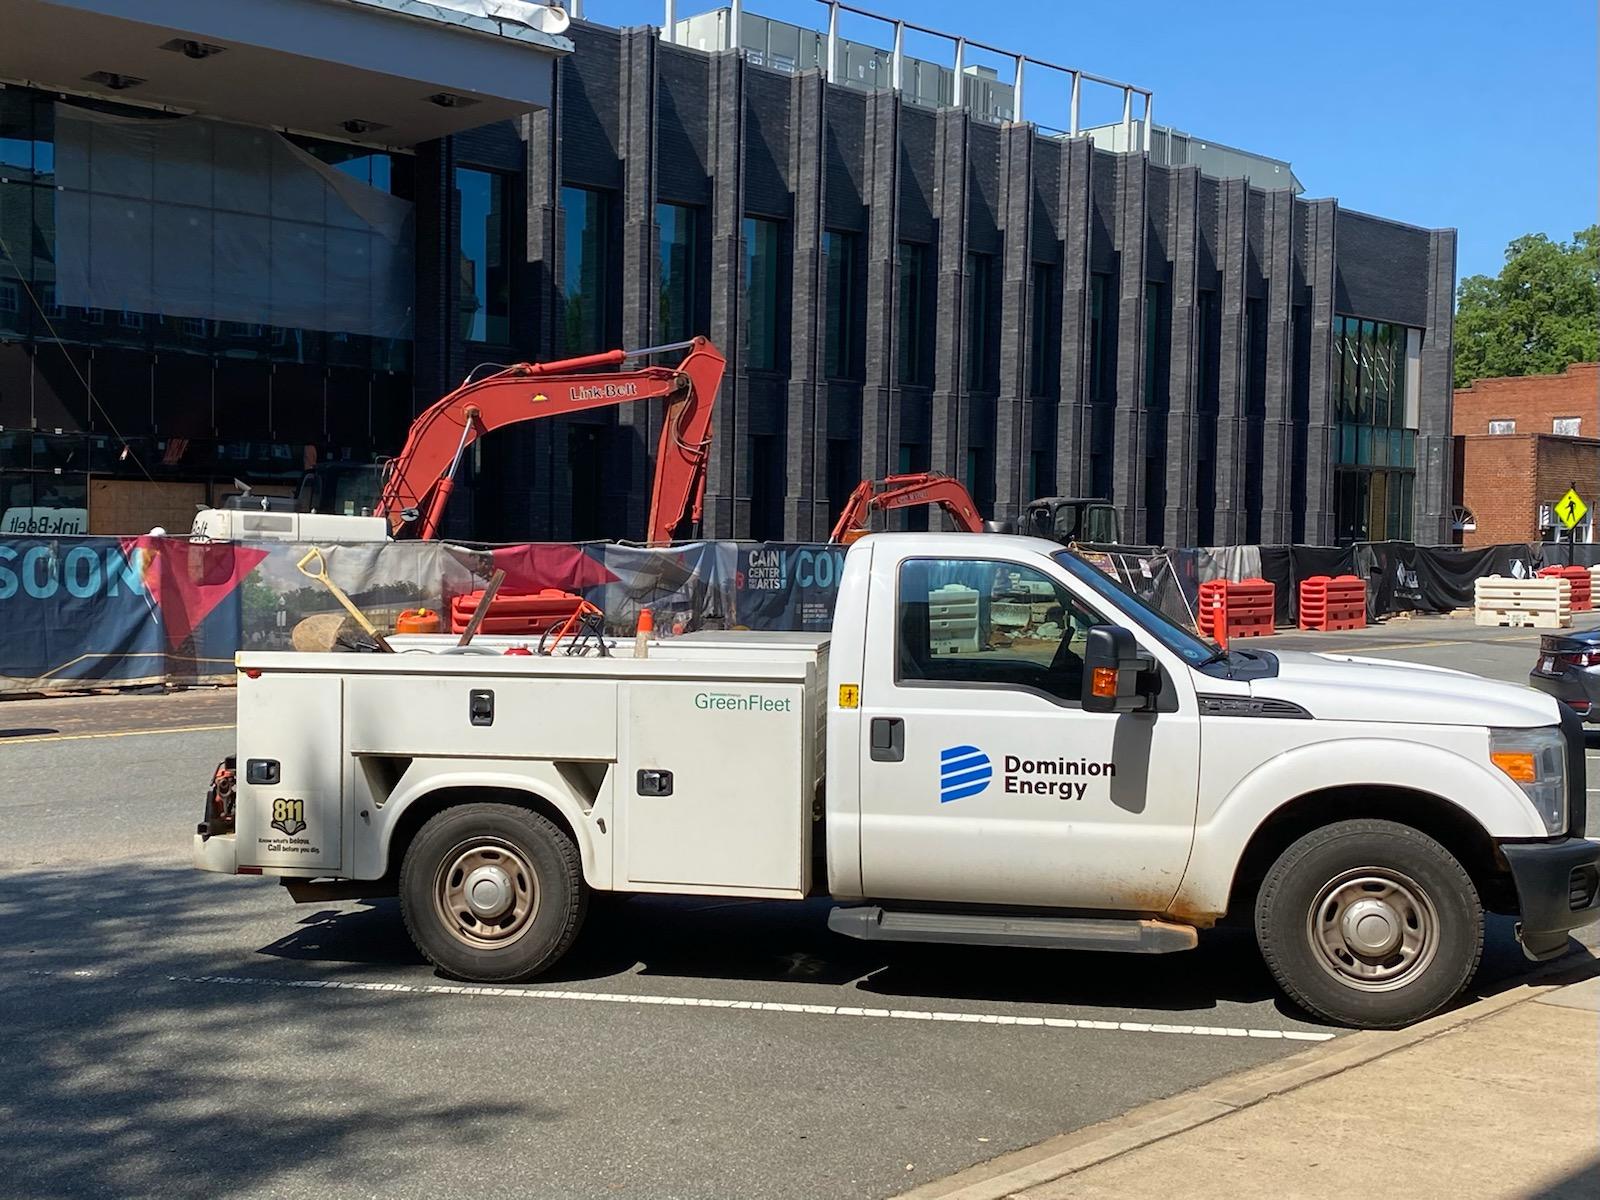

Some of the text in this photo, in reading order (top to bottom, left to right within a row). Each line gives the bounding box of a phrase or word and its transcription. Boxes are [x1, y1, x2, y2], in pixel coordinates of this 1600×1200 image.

[570, 383, 637, 400] Link-Belt
[748, 550, 780, 567] CAIN
[748, 567, 780, 578] CENTER
[757, 578, 781, 590] ARTS
[695, 692, 791, 712] GreenFleet
[1005, 755, 1116, 777] Dominion
[1005, 776, 1088, 801] Energy
[273, 798, 304, 822] 811
[267, 844, 281, 852] Call
